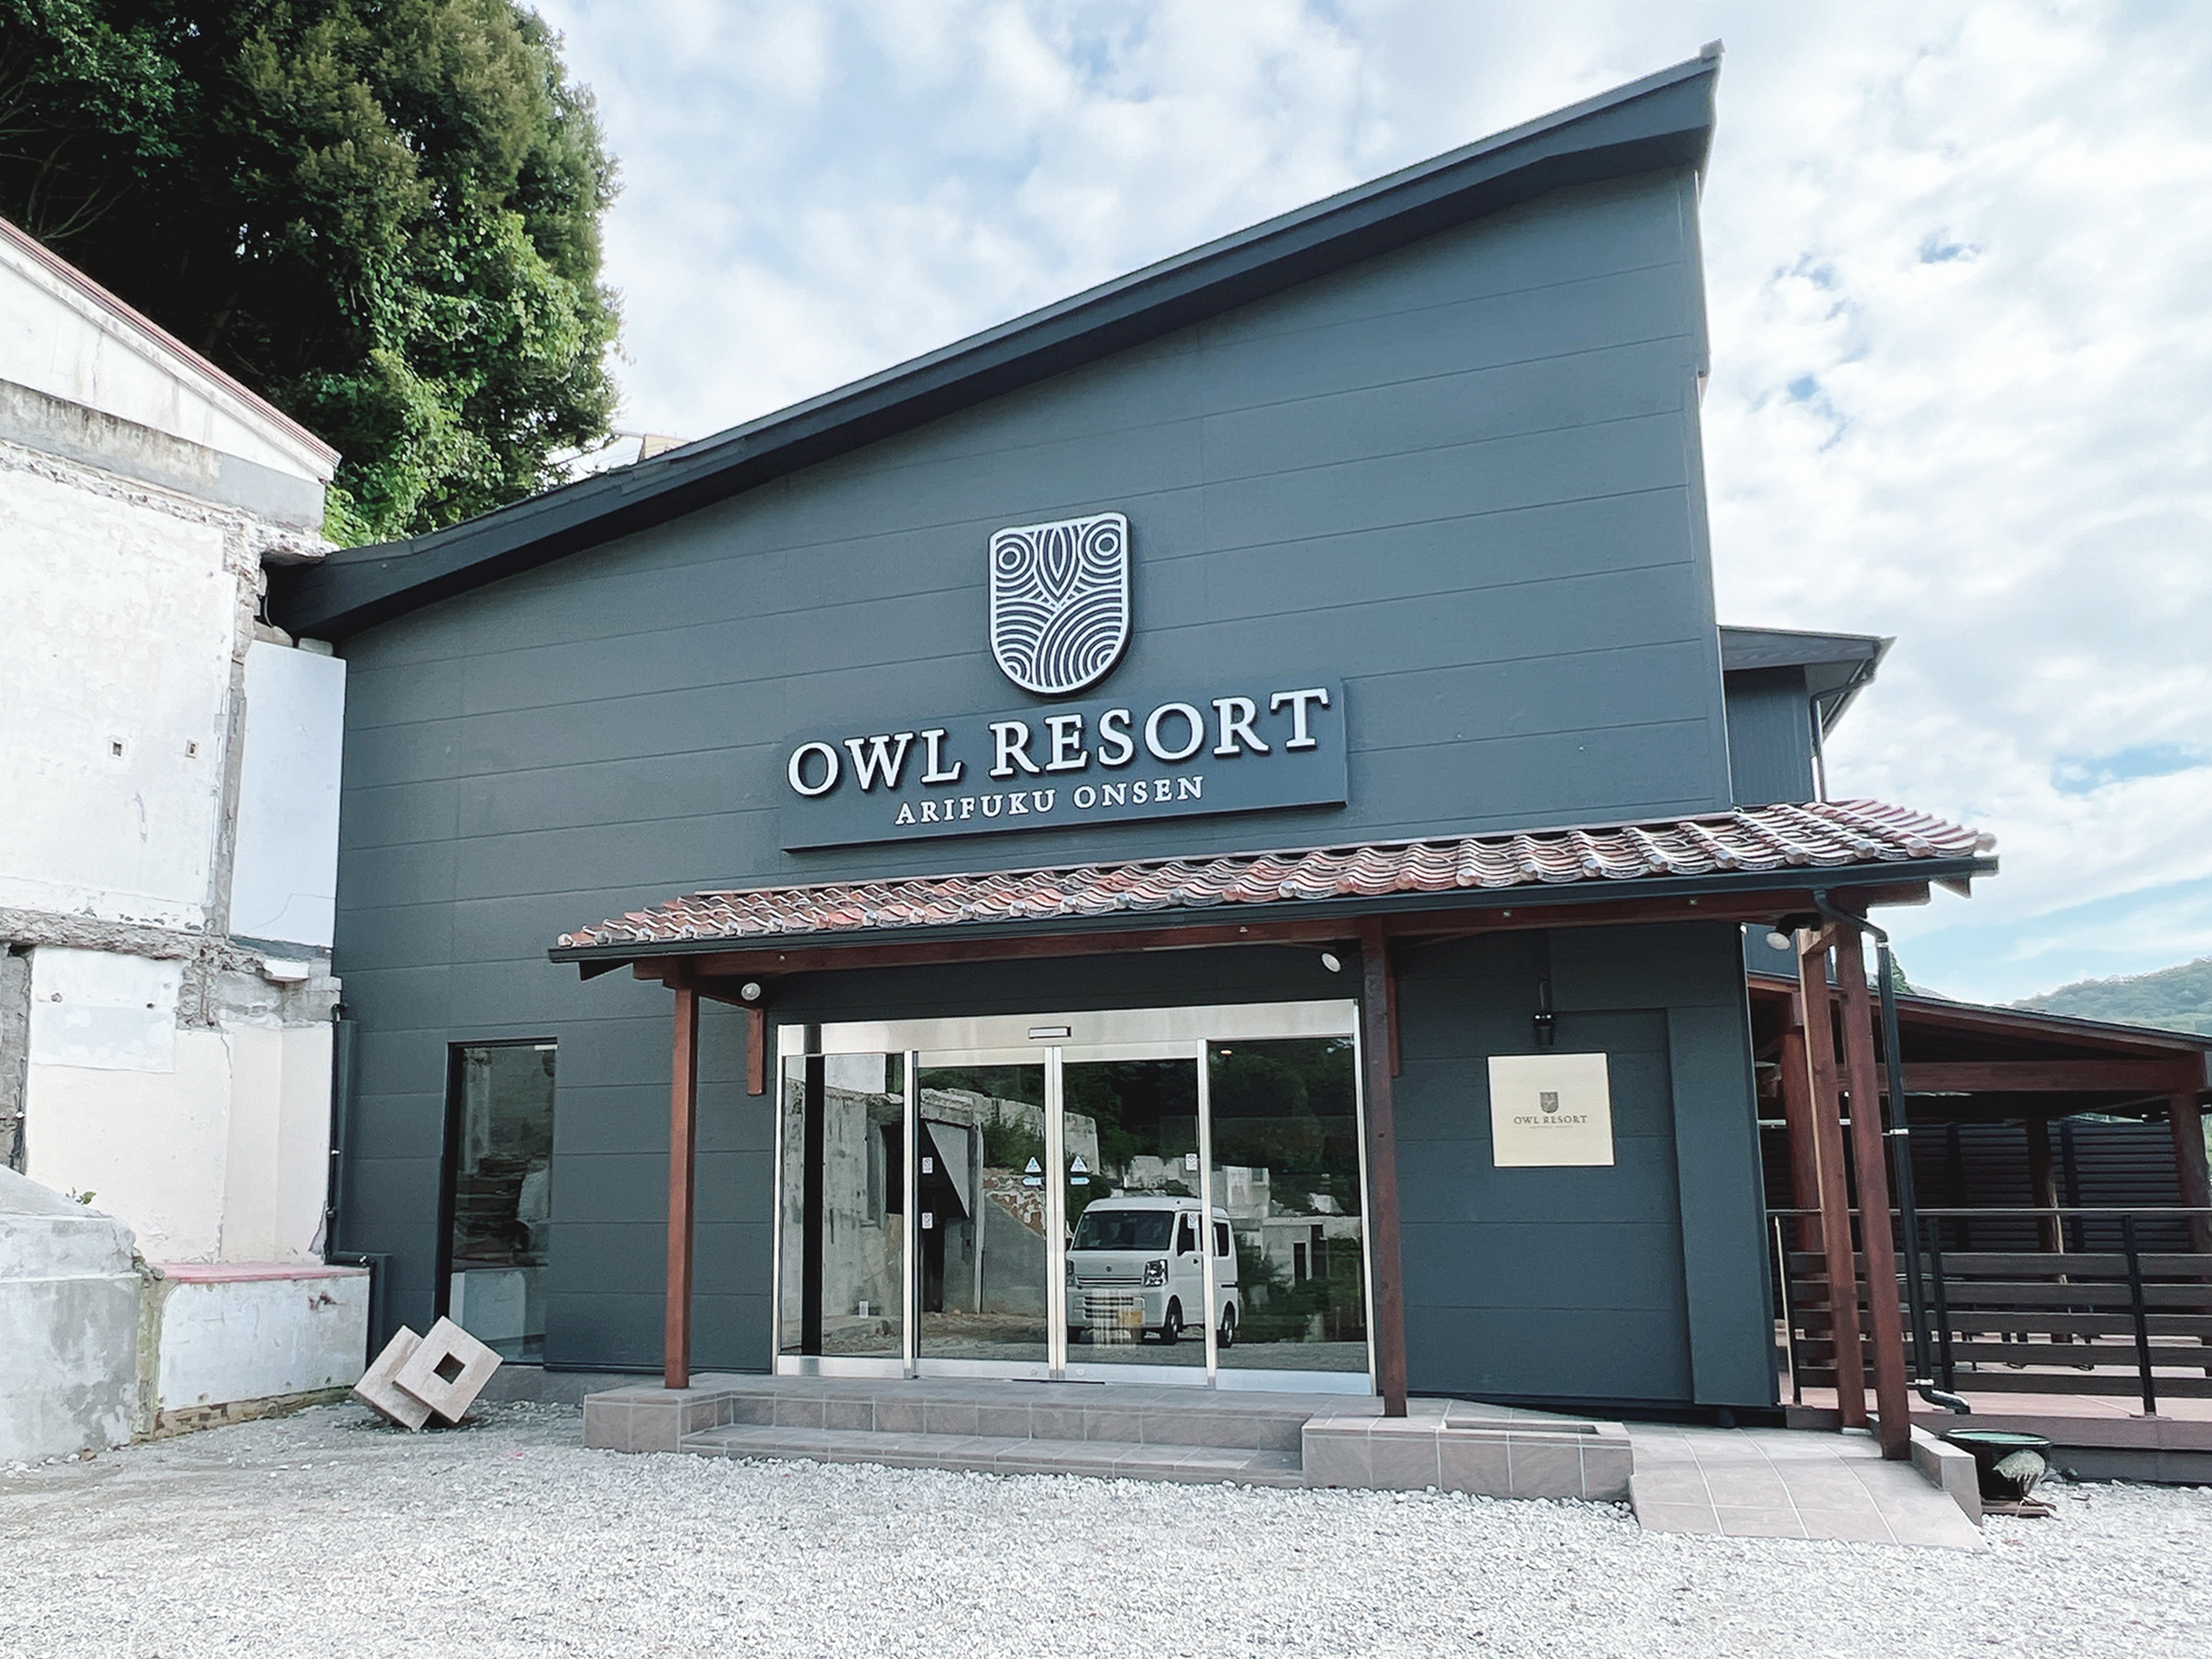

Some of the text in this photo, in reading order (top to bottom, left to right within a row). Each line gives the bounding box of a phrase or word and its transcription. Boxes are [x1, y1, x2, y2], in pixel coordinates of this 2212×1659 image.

[787, 687, 1330, 796] OWL RESORT
[895, 776, 1203, 826] ARIFUKU ONSEN
[1513, 1115, 1588, 1125] OWL RESORT
